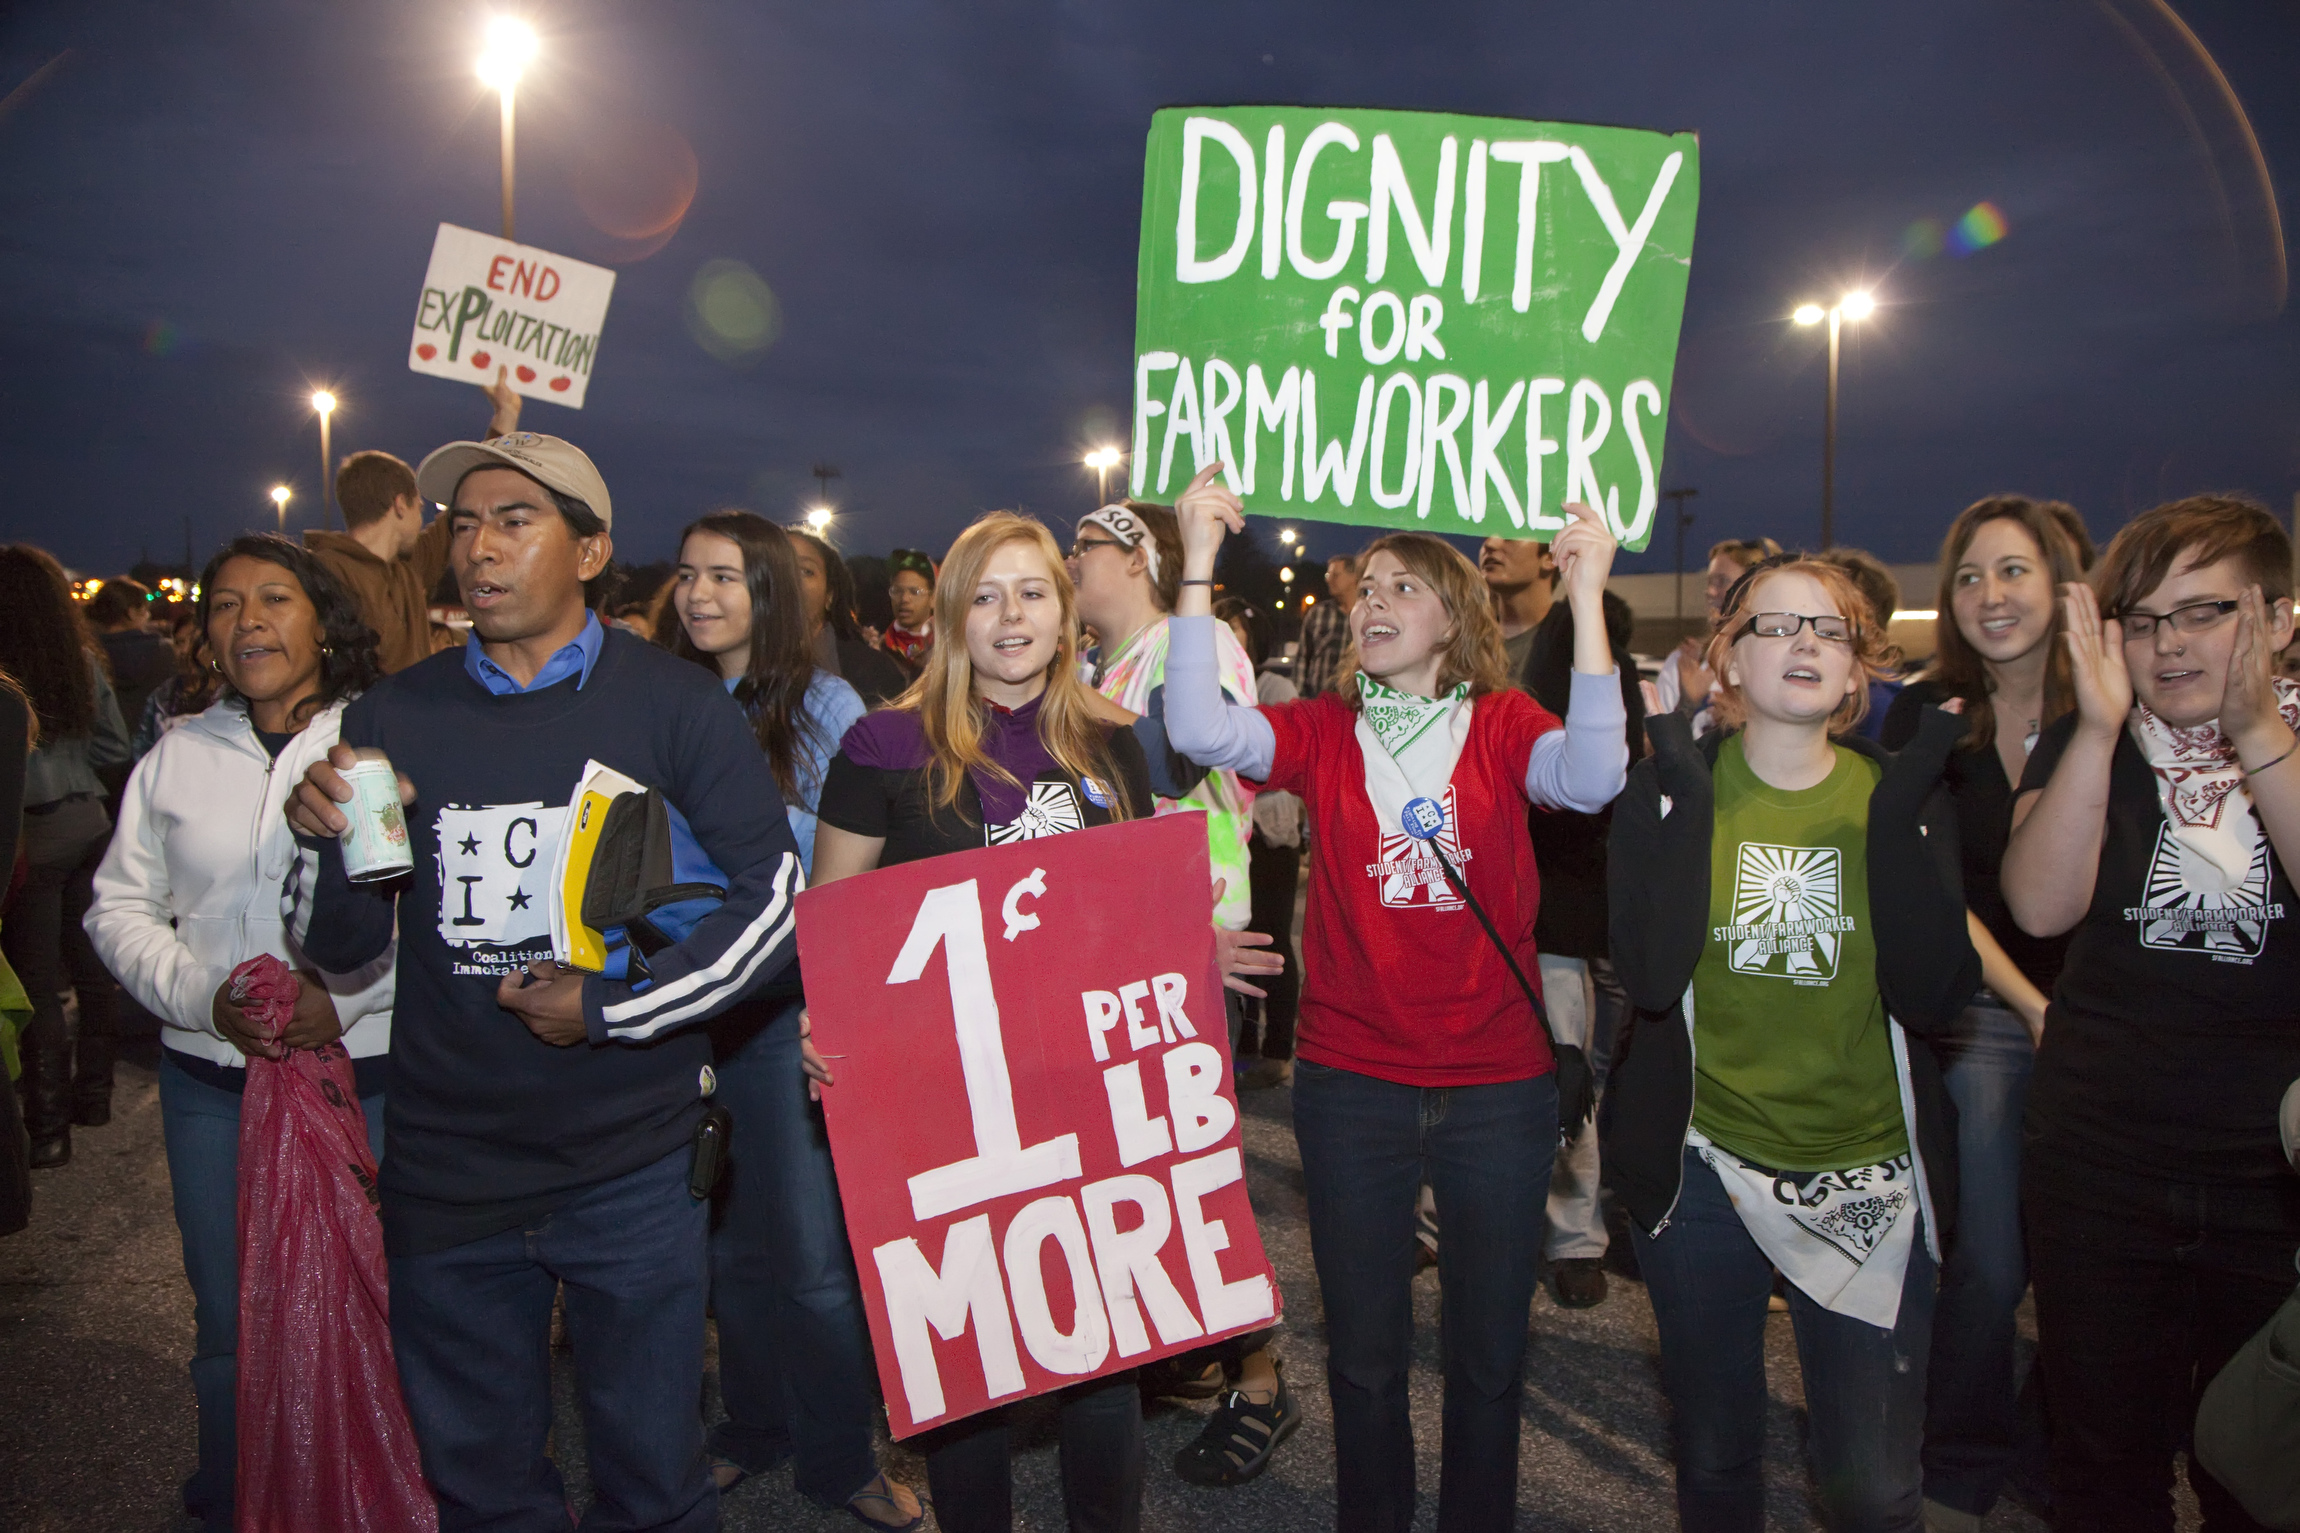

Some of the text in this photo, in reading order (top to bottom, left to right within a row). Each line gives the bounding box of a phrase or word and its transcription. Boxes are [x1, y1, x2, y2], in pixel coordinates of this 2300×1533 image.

[1175, 116, 1683, 343] DIGNITY
[486, 254, 561, 302] END
[416, 284, 600, 375] EXPLOITATION
[1131, 352, 1662, 543] FARMWORKERS
[1102, 509, 1146, 546] SOA
[503, 816, 538, 869] C
[1365, 848, 1474, 878] STUDENT/FARMRKER
[452, 875, 486, 926] I
[1403, 868, 1446, 889] ALLIANCE
[1758, 936, 1815, 956] ALLIANCE
[2173, 921, 2236, 933] ALLIANCE
[472, 949, 554, 964] Coalition
[1081, 972, 1198, 1063] PER
[1103, 1041, 1236, 1168] LB
[872, 1147, 1274, 1425] MORE
